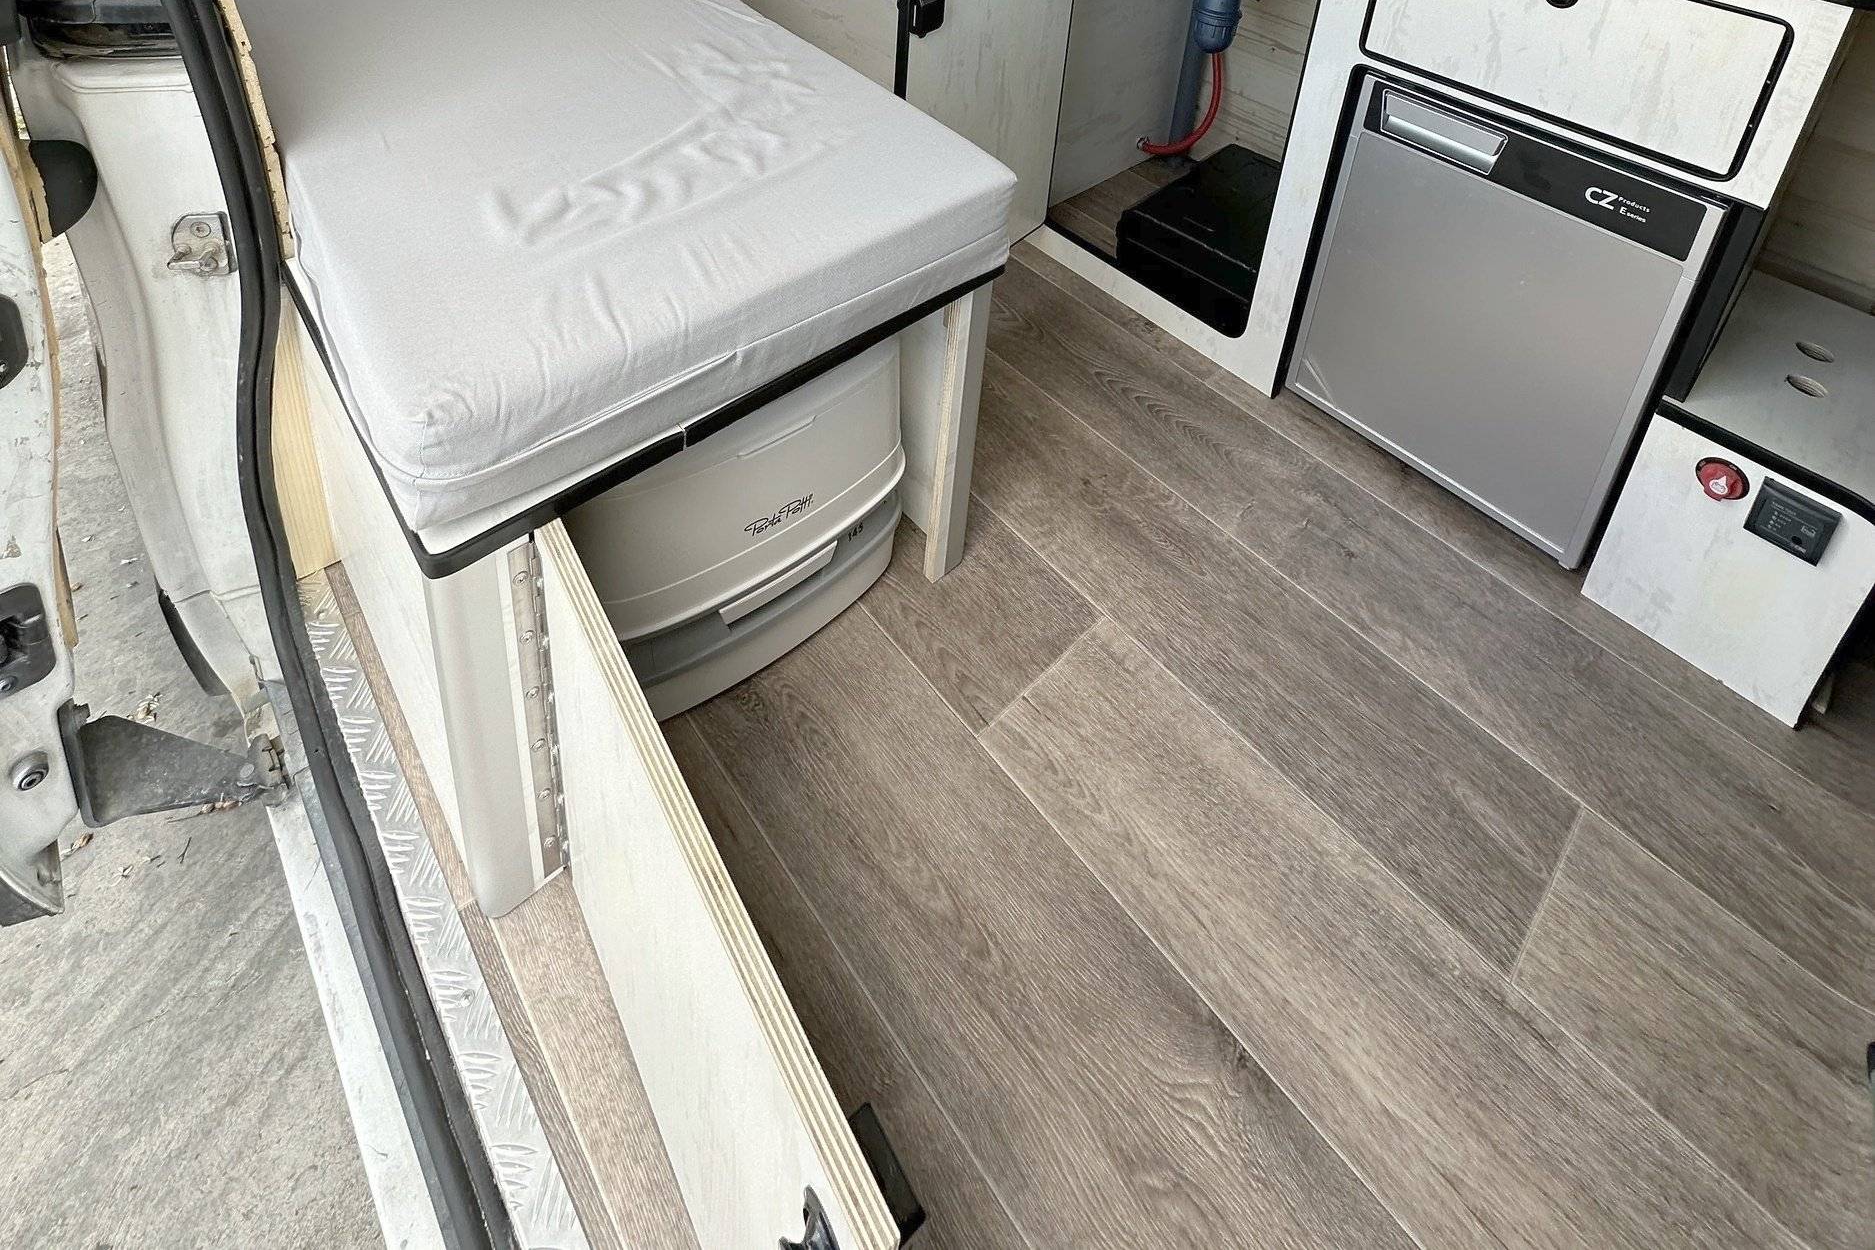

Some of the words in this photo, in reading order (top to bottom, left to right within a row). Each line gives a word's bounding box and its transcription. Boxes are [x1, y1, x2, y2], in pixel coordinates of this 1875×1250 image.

[1585, 187, 1618, 210] CZ
[1619, 196, 1650, 213] Products
[744, 513, 781, 536] Porta
[779, 493, 813, 518] Potti
